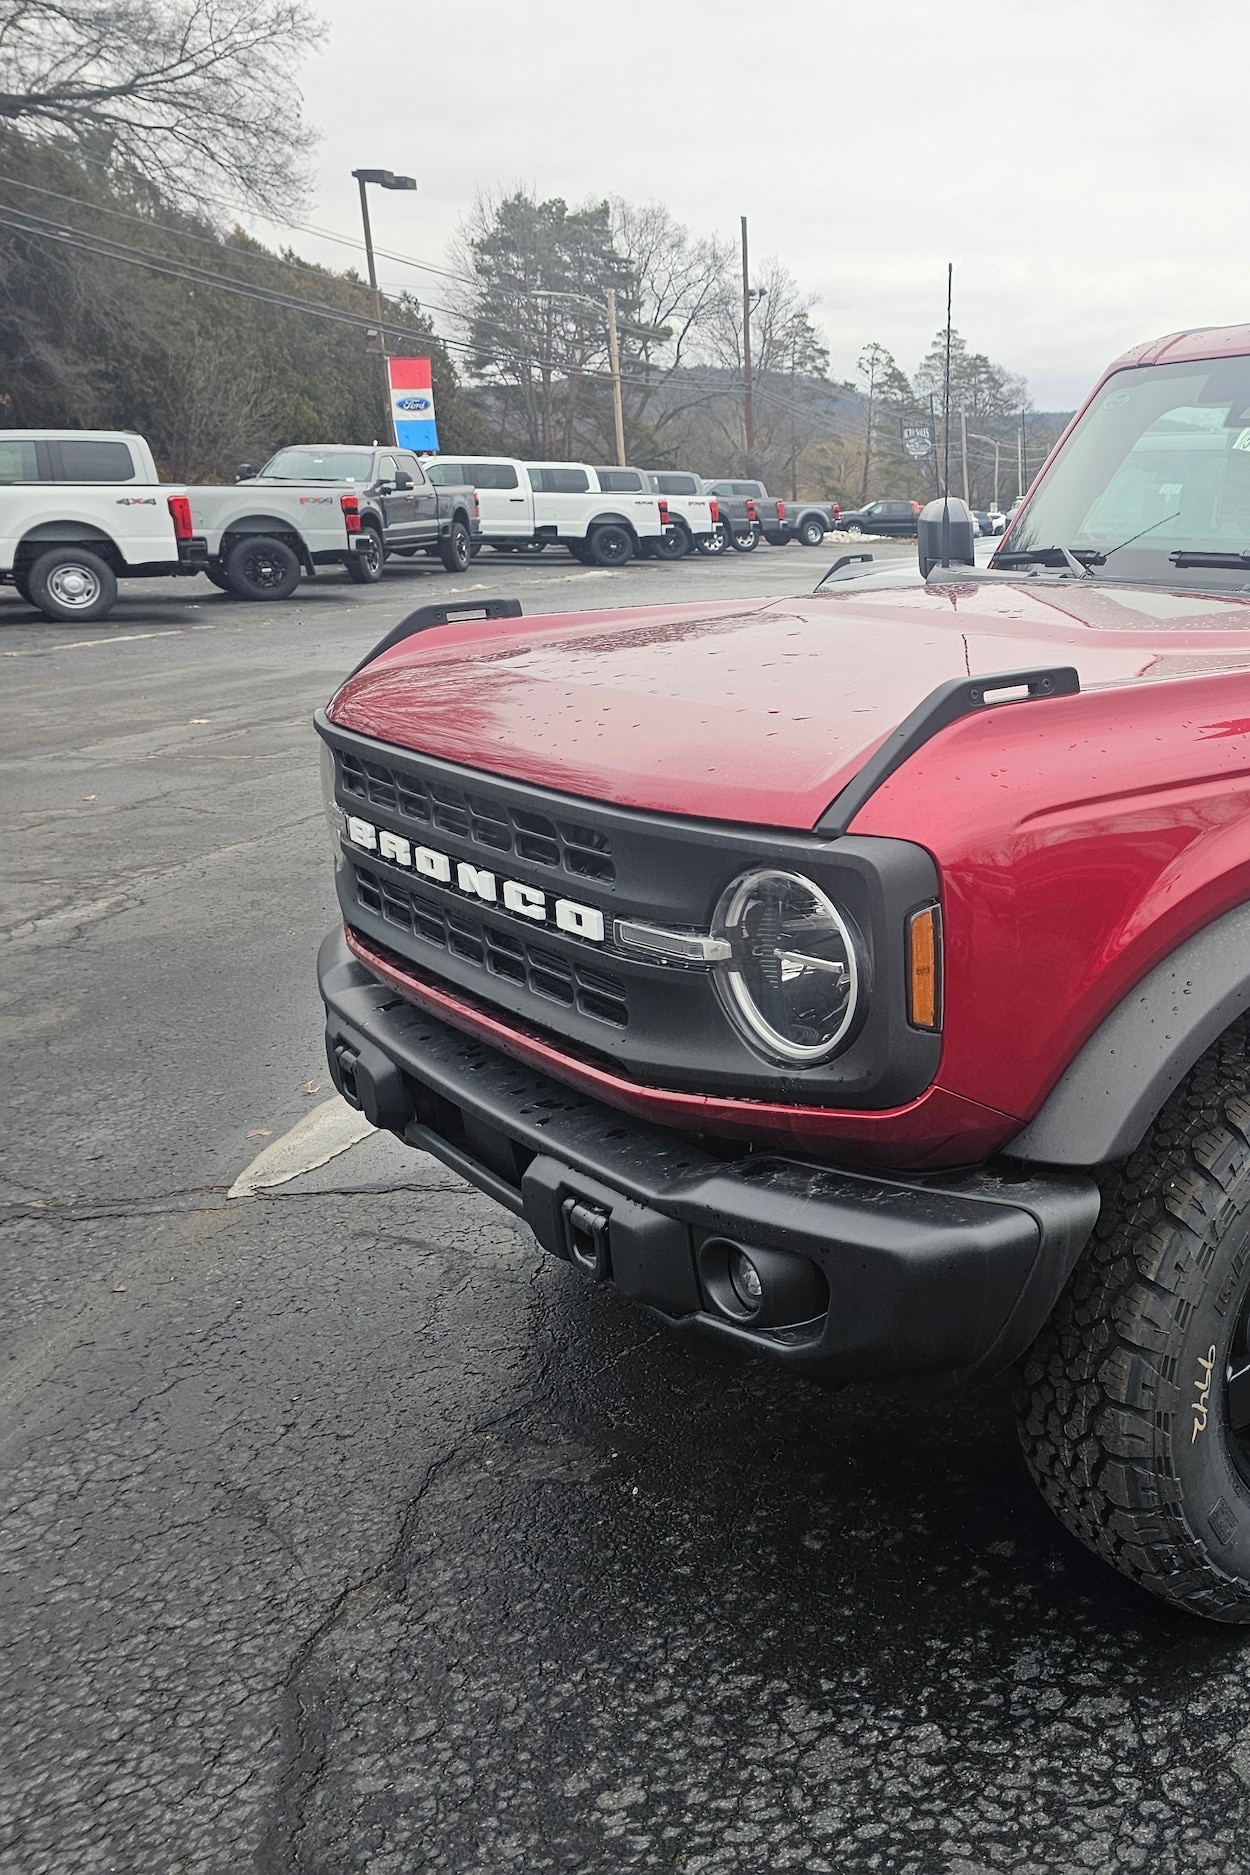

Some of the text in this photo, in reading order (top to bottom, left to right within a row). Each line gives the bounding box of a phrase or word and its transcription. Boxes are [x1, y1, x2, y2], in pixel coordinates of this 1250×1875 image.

[402, 399, 426, 410] Ford
[299, 496, 333, 505] FX4
[349, 815, 605, 942] BRONCO
